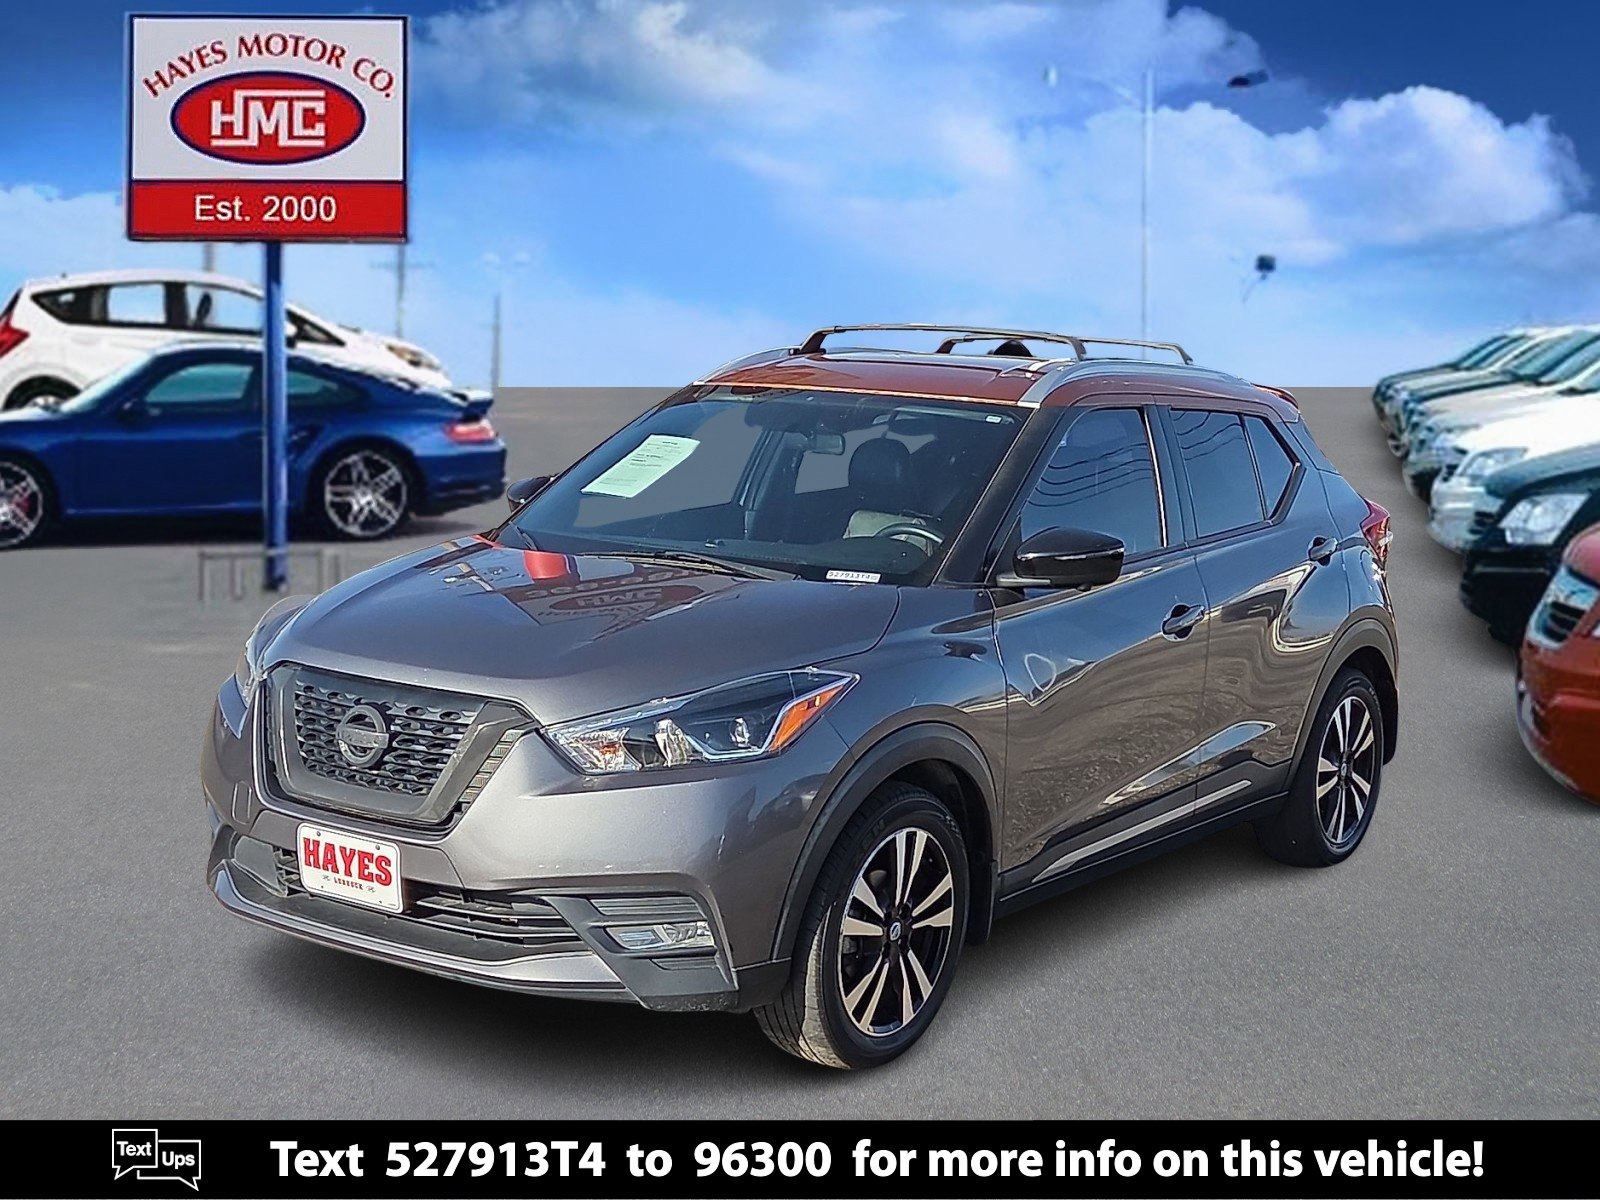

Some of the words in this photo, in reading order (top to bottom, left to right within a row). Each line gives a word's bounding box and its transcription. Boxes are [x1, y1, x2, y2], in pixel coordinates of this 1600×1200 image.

[143, 40, 228, 97] HAYES
[237, 32, 347, 70] MOTOR
[352, 57, 395, 99] CO.
[210, 88, 326, 147] HMC
[194, 194, 251, 222] Est.
[262, 195, 337, 222] 2000
[303, 837, 392, 886] HAYES
